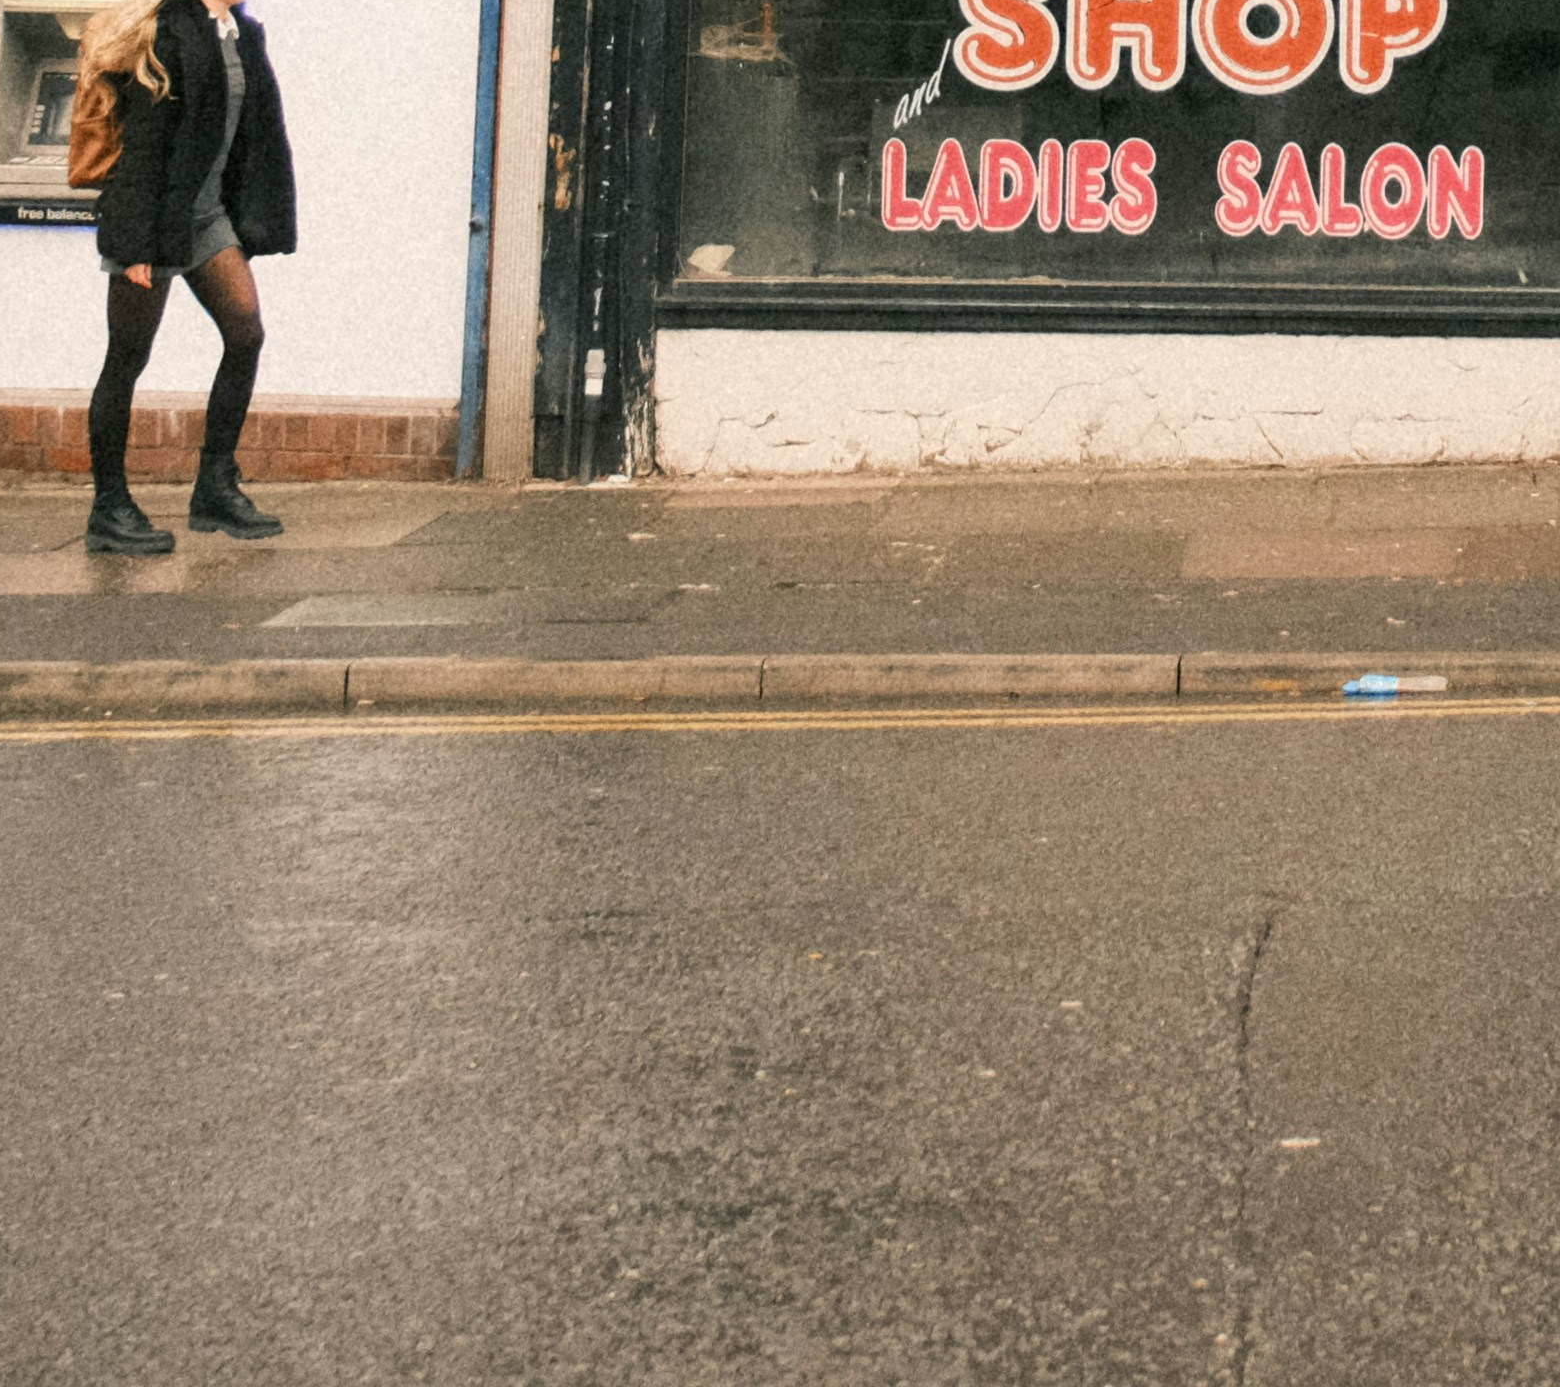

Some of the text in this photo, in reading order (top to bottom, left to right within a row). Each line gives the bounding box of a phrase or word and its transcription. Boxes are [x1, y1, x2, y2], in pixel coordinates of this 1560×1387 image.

[892, 38, 951, 129] and
[18, 207, 44, 219] free
[881, 136, 1485, 240] LADIES SALON
